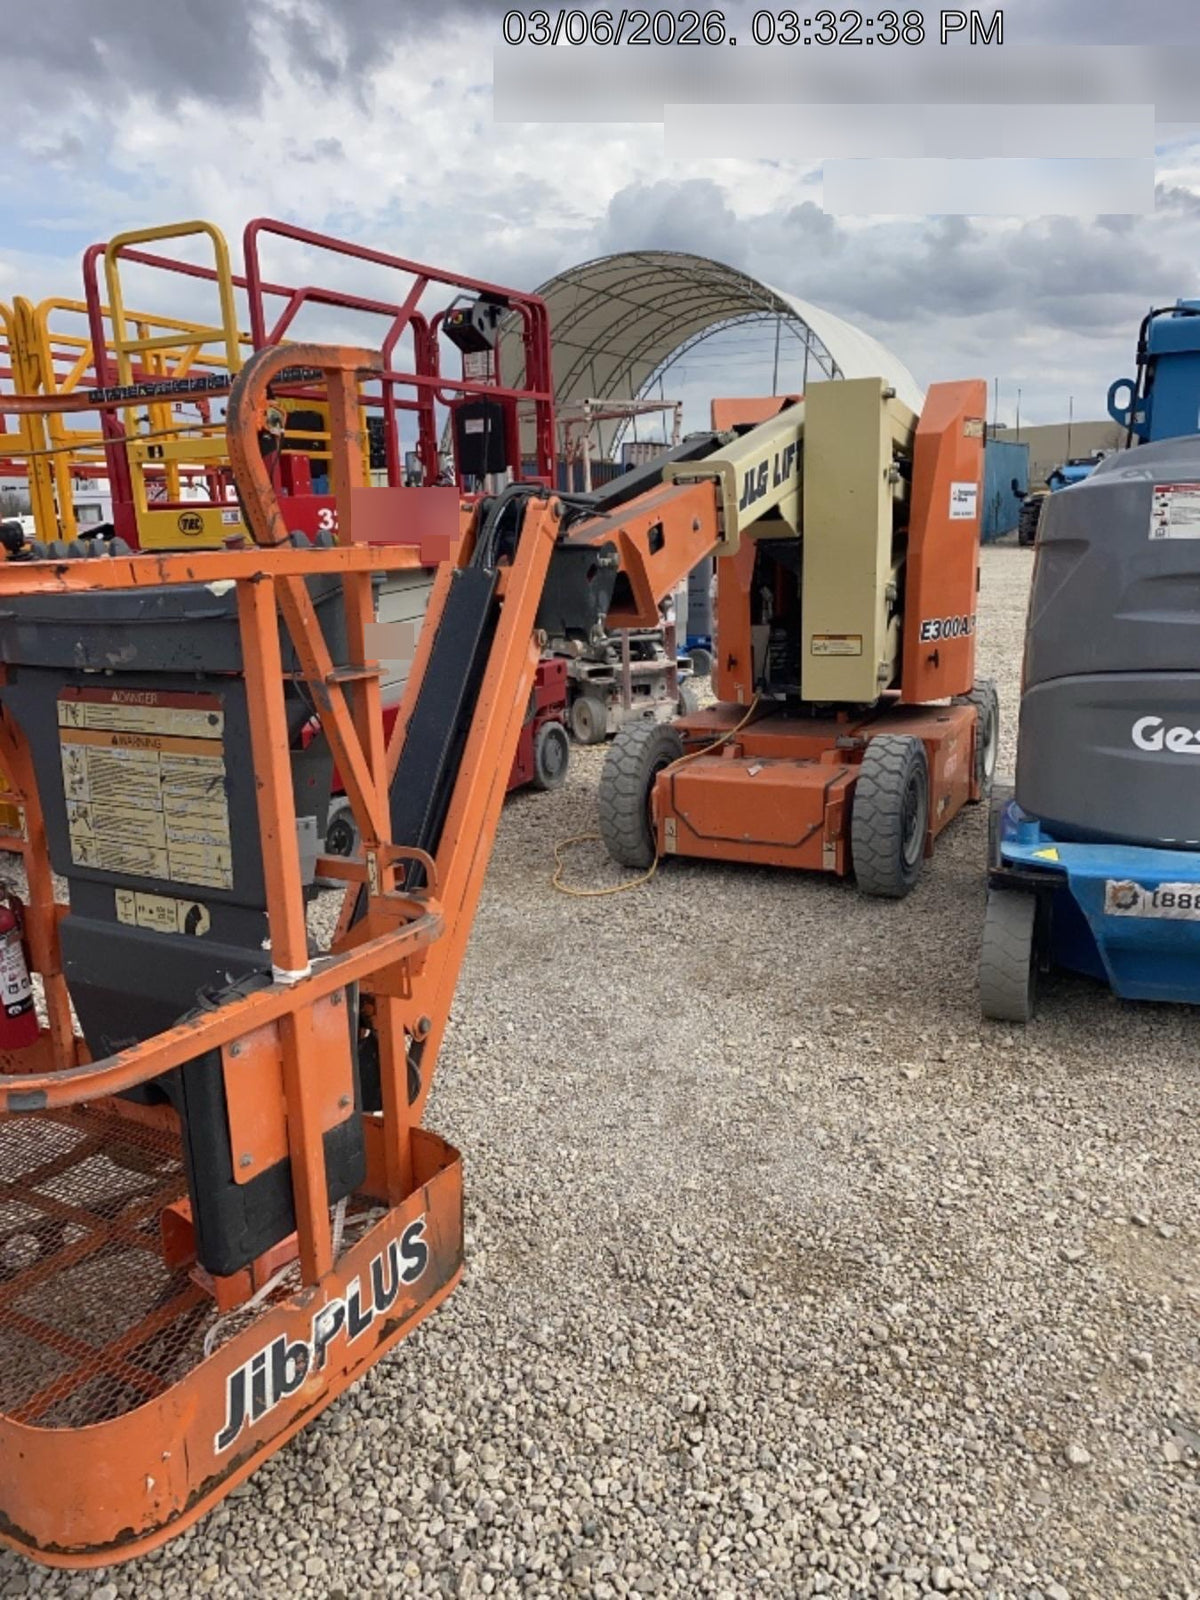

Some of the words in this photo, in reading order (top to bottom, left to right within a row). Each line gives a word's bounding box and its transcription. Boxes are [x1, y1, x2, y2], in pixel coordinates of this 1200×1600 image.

[739, 459, 768, 512] JLG
[119, 690, 159, 705] DANGER
[119, 735, 162, 750] WARNING
[214, 1212, 429, 1456] JibPLUS
